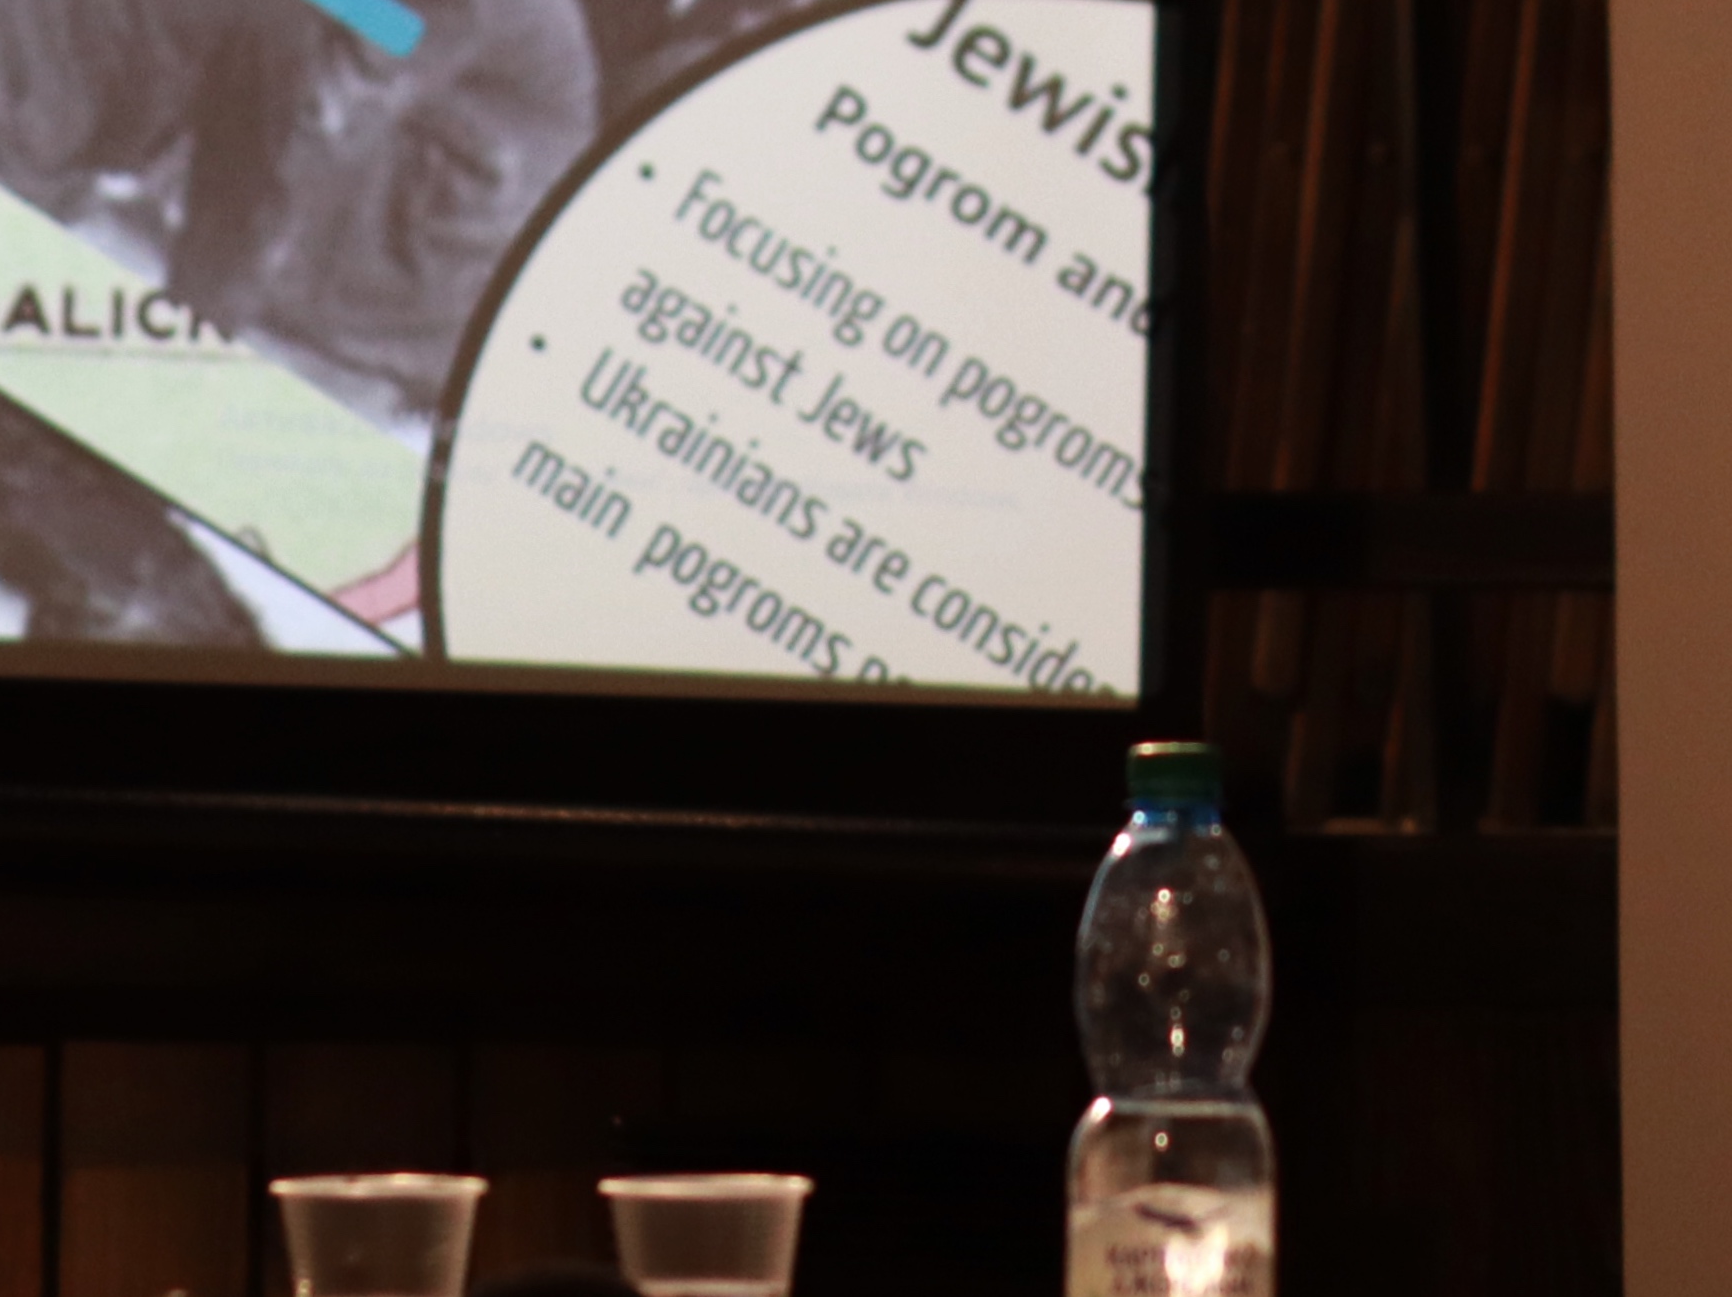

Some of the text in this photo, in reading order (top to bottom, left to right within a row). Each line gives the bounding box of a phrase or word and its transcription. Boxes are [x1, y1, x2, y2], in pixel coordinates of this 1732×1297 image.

[673, 167, 888, 351] Focusing
[879, 312, 952, 380] on
[813, 83, 1051, 267] Pogrom
[618, 267, 805, 407] against
[797, 373, 928, 485] Jews
[510, 438, 634, 541] main
[631, 522, 854, 681] pogroms
[578, 347, 830, 544] Ukrainians
[823, 517, 913, 597] are
[909, 572, 1116, 692] conside
